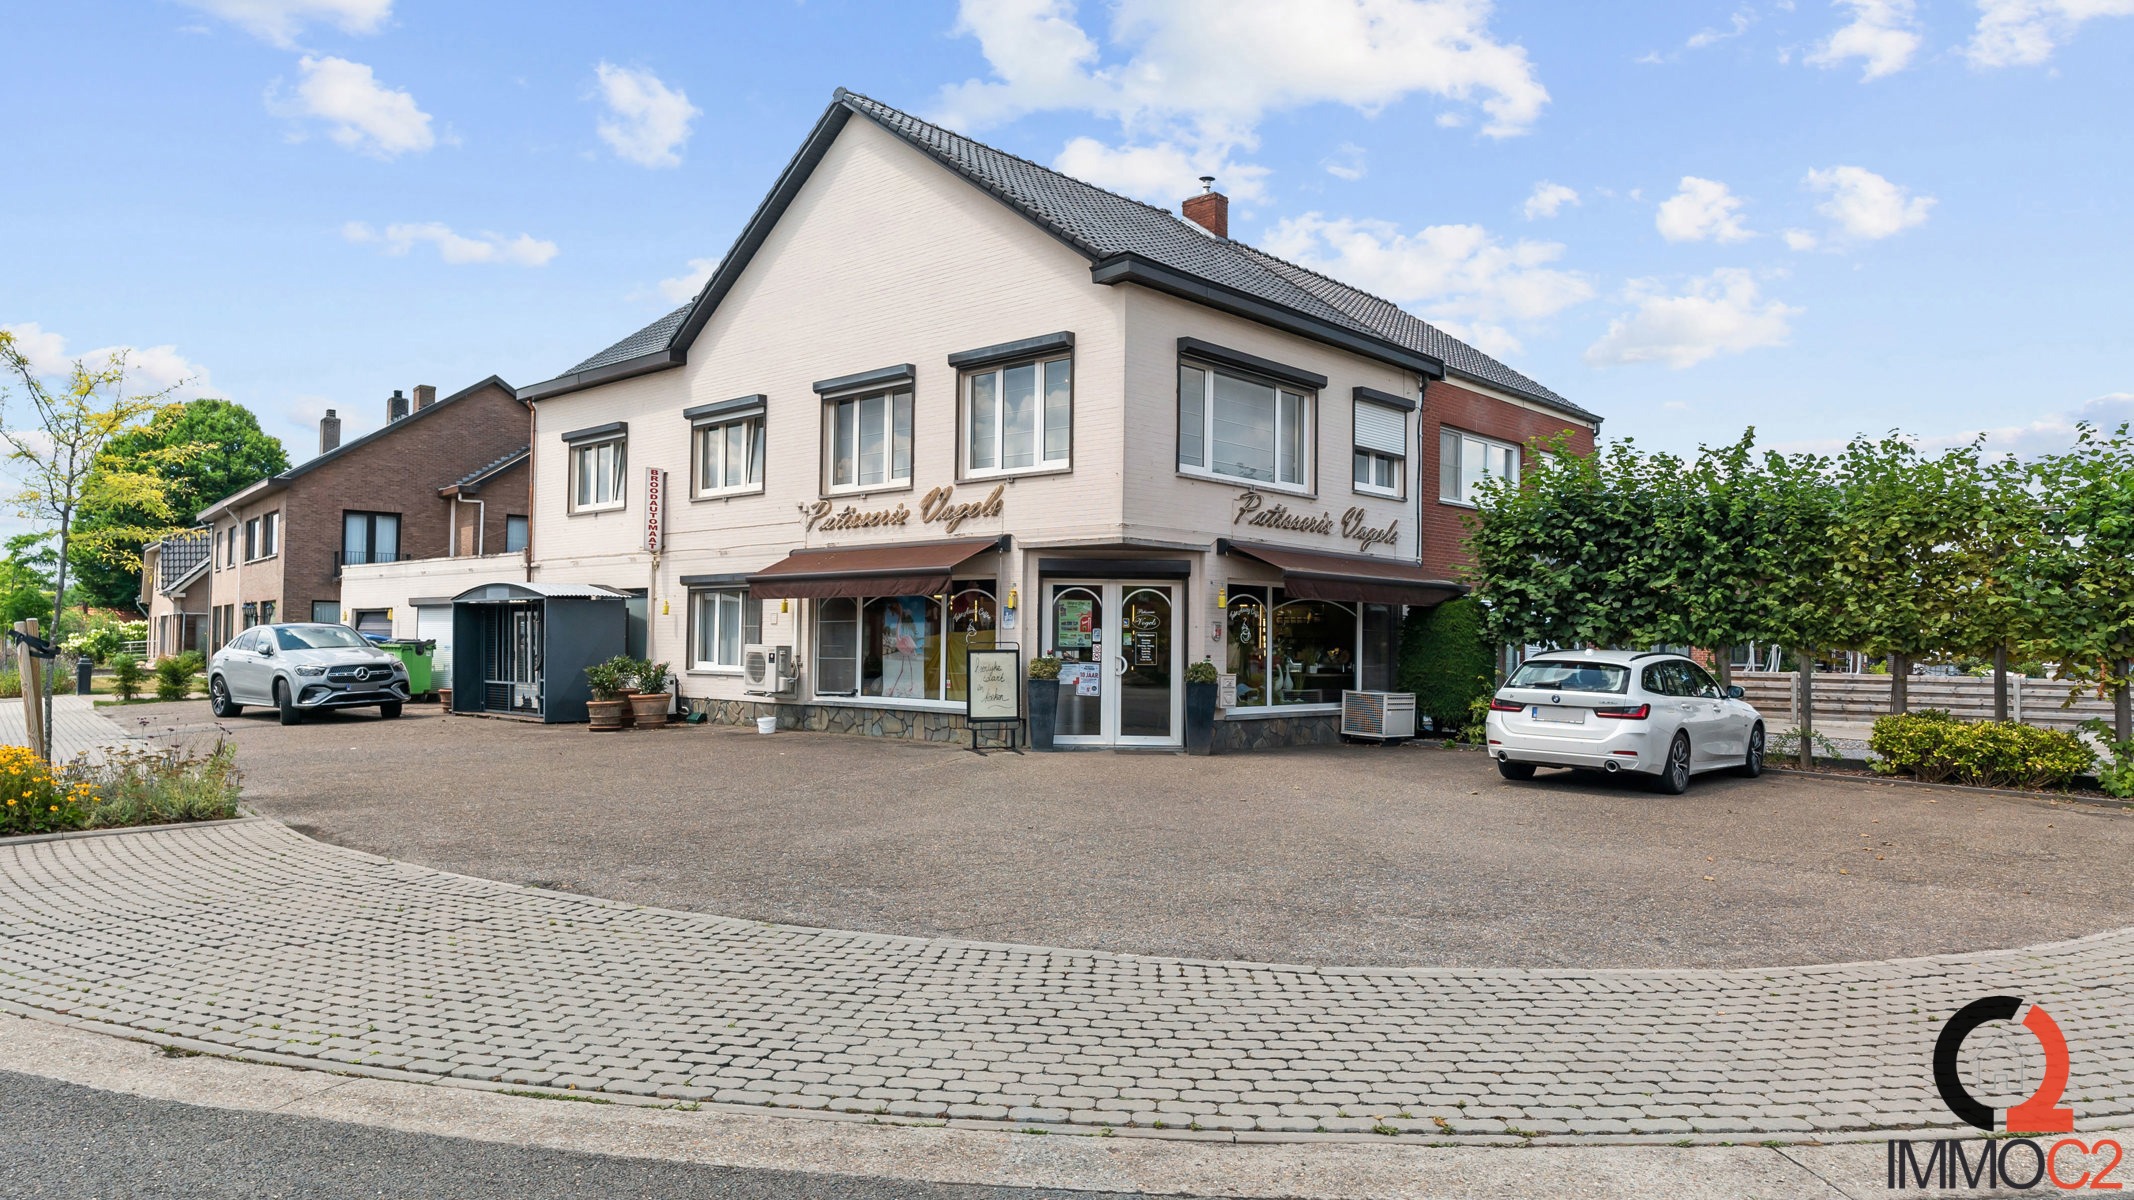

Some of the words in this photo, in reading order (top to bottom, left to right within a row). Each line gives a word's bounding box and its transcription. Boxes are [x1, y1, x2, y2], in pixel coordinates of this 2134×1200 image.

[648, 469, 659, 549] BROODAUTOMAAT
[806, 499, 910, 532] Patisserie
[919, 485, 1004, 534] Vogels
[1233, 492, 1333, 535] Patisserie
[1341, 506, 1398, 552] Vogels
[1136, 617, 1157, 629] Vogels
